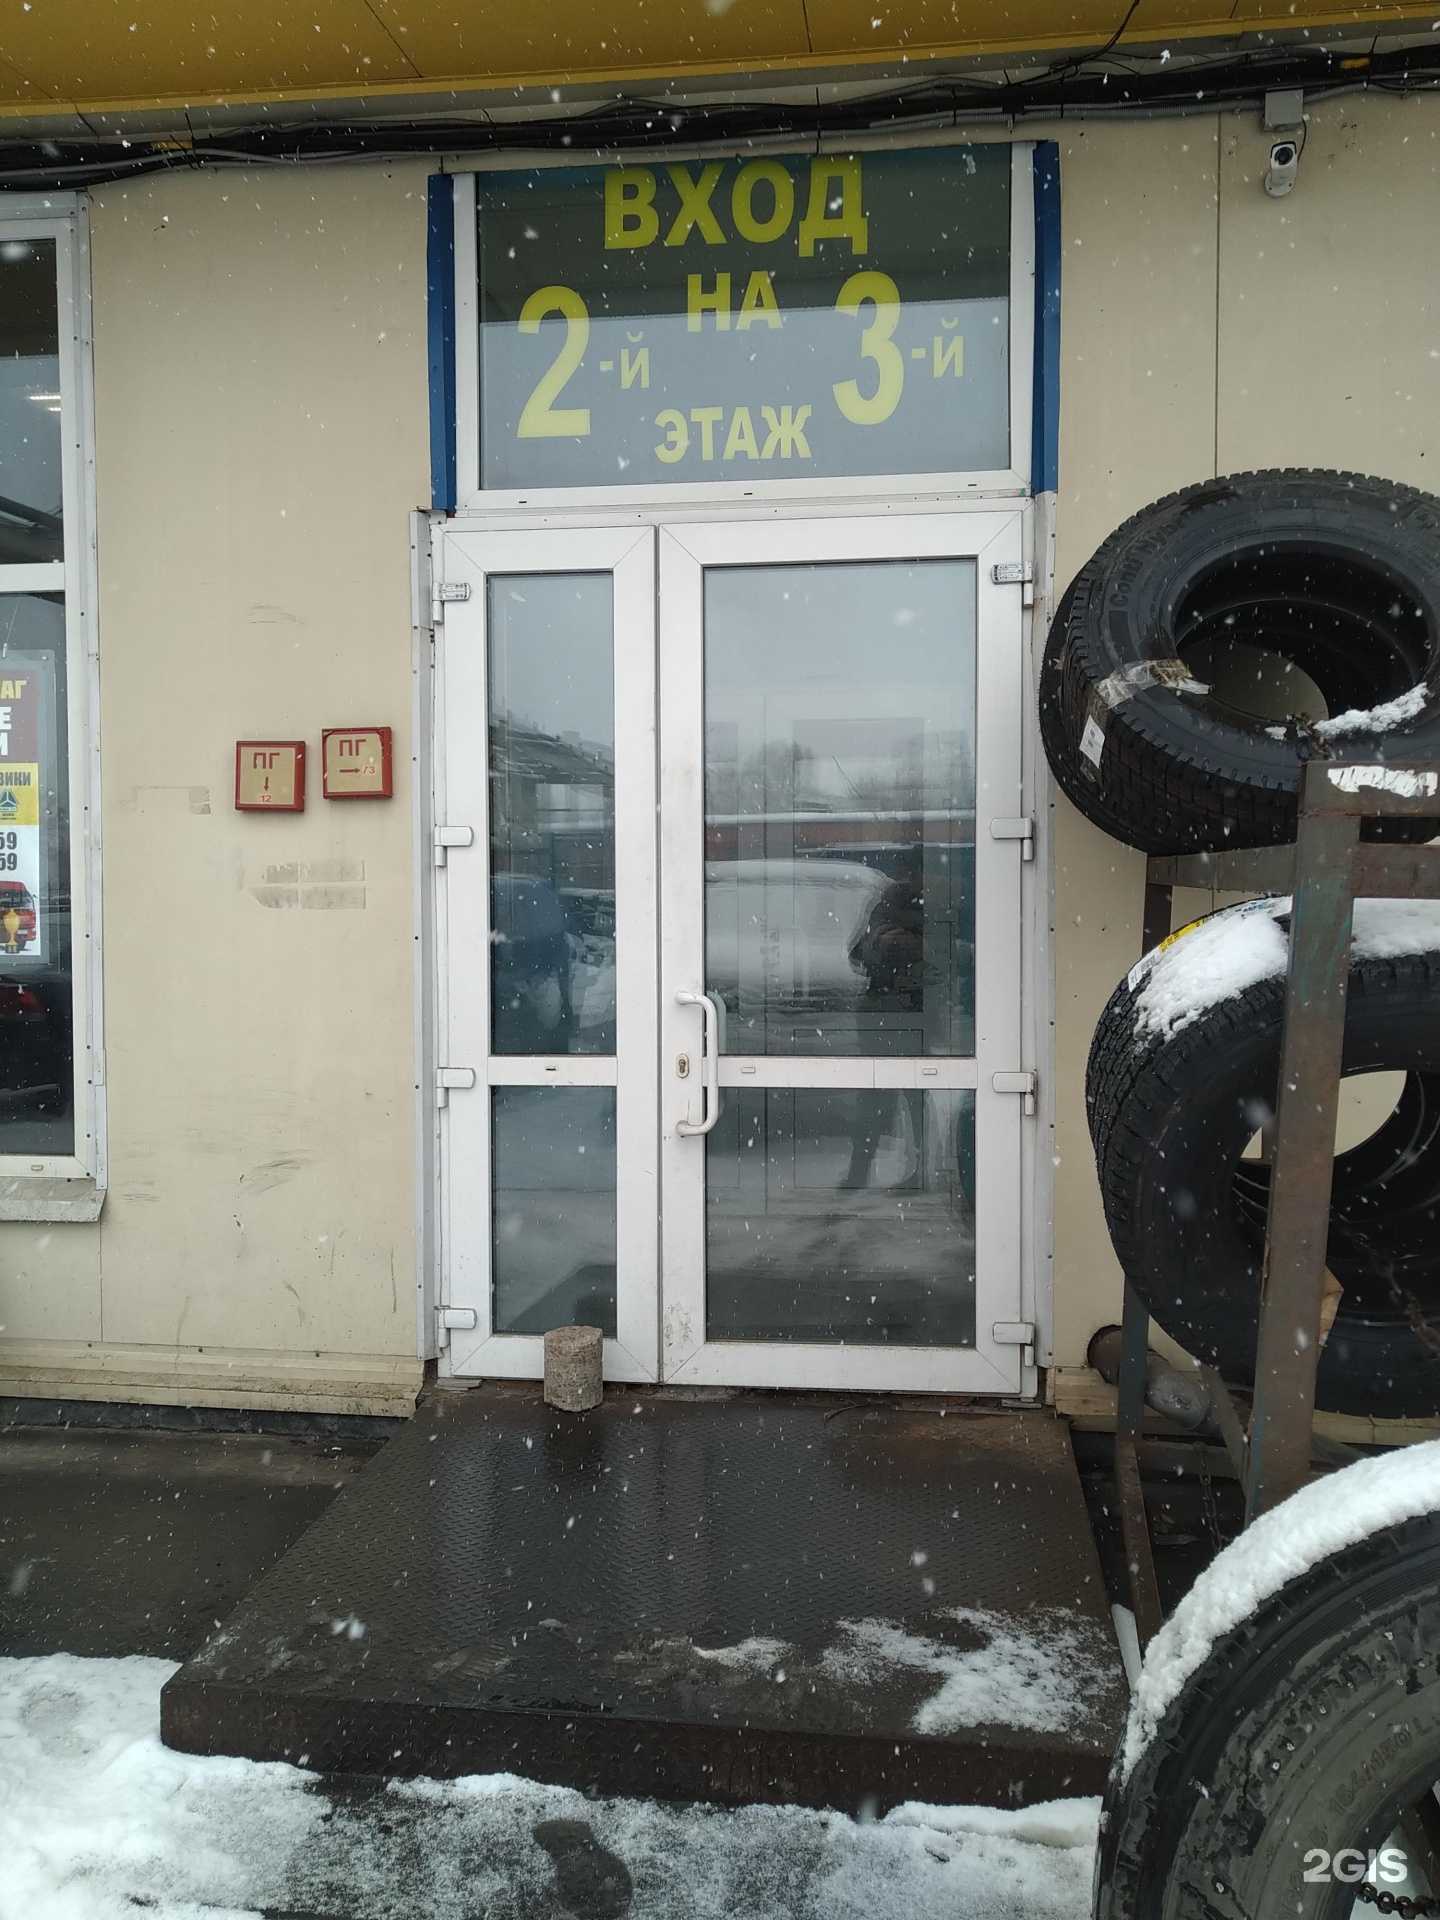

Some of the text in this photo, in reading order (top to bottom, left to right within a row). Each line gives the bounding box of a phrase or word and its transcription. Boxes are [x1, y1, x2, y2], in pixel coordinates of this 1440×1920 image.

[604, 155, 869, 258] ВХОД
[687, 270, 784, 333] НА
[654, 403, 813, 465] ЭТАЖ
[254, 752, 280, 769] ПГ
[340, 739, 366, 756] ПГ
